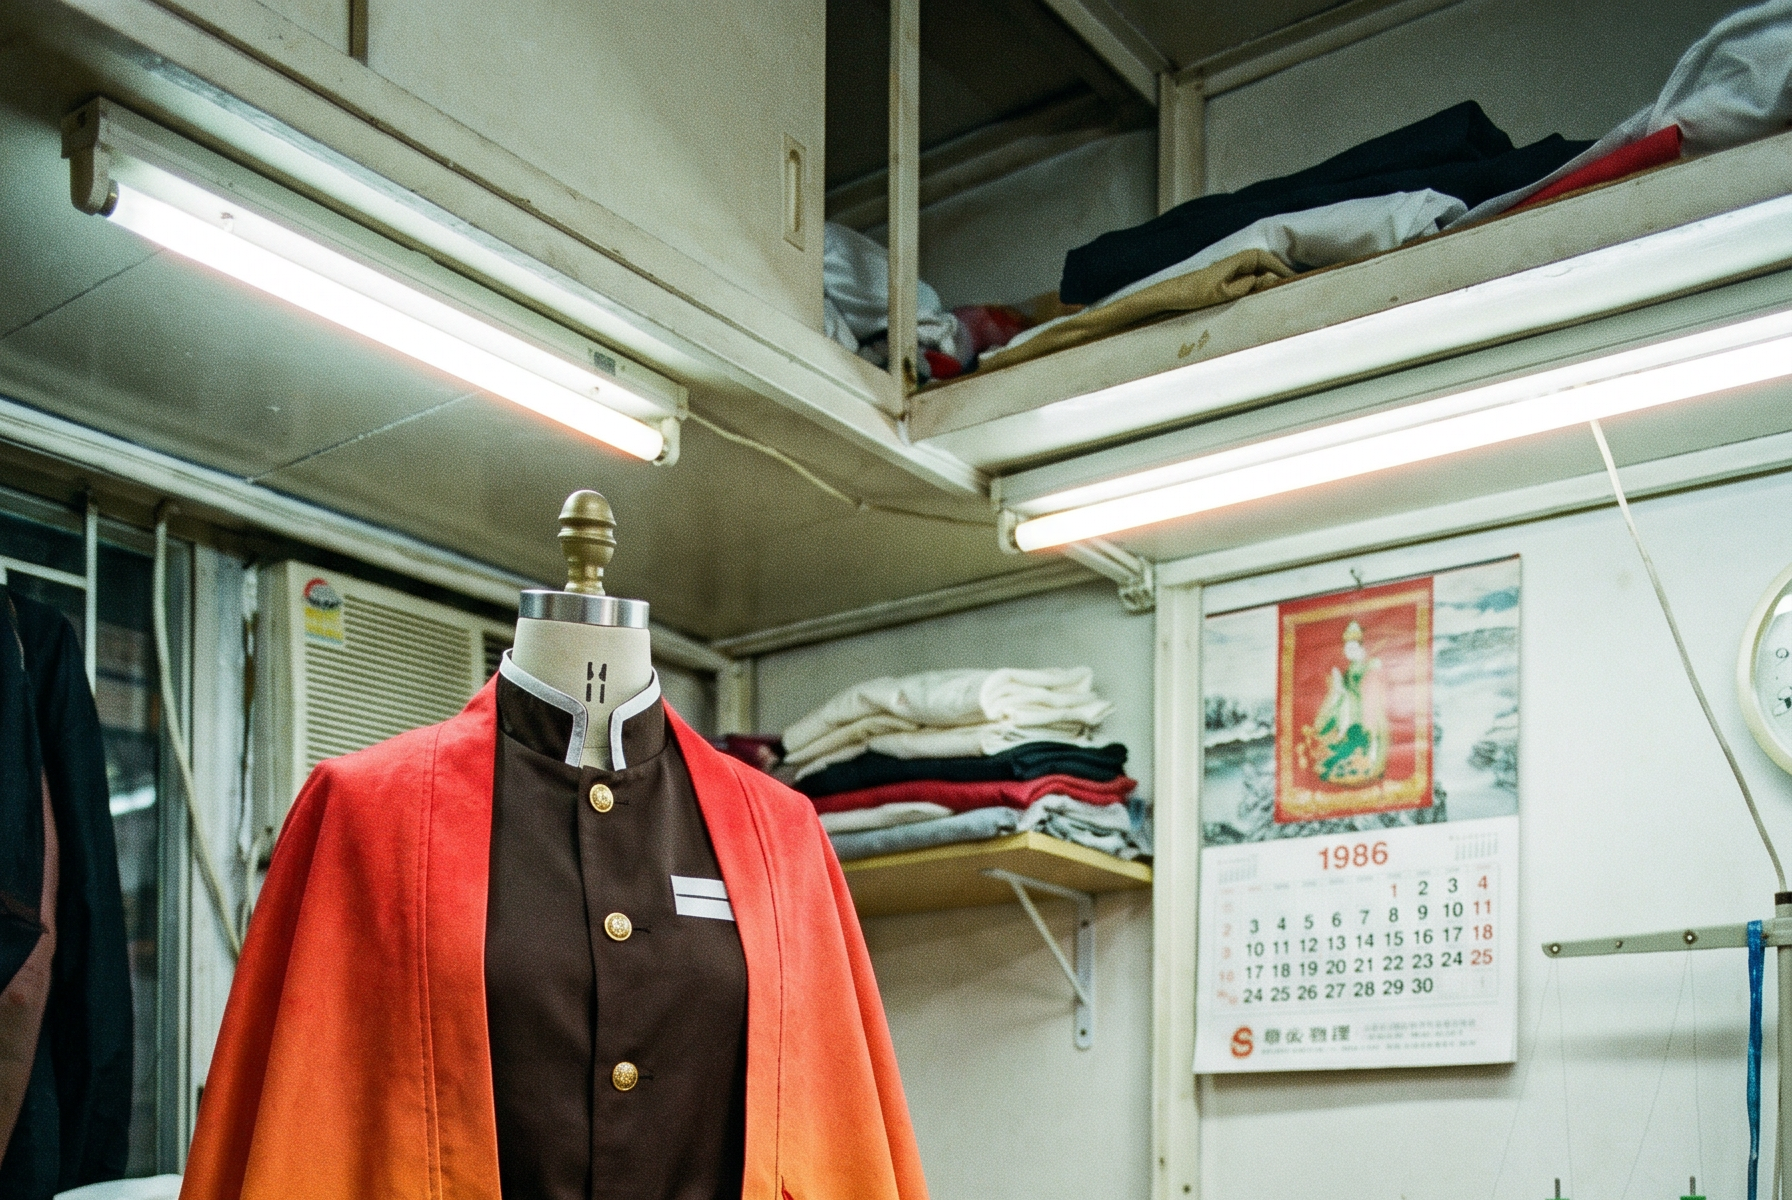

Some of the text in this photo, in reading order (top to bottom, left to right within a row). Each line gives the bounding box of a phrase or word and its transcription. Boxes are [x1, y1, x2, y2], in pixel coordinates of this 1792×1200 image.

[1318, 840, 1389, 871] 1986
[1390, 875, 1489, 898] 1 2 3 4
[1249, 918, 1260, 935] 3
[1276, 916, 1287, 931] 4
[1303, 913, 1315, 930] 5
[1331, 911, 1343, 928] 6
[1359, 909, 1370, 925] 7
[1388, 906, 1399, 924] 8
[1417, 904, 1429, 921] 9
[1443, 901, 1464, 918] 10
[1473, 899, 1492, 916] 11
[1245, 941, 1265, 958] 10
[1272, 940, 1290, 955] 11
[1299, 937, 1319, 954] 12
[1327, 935, 1347, 951] 13
[1355, 932, 1375, 949] 14
[1384, 930, 1405, 947] 15
[1413, 928, 1434, 945] 16
[1443, 925, 1464, 943] 17
[1472, 923, 1494, 941] 18
[1245, 964, 1264, 980] 17
[1272, 962, 1291, 979] 18
[1299, 960, 1319, 977] 19
[1325, 959, 1347, 976] 20
[1354, 956, 1374, 974] 21
[1382, 954, 1405, 972] 22
[1411, 952, 1434, 970] 23
[1440, 950, 1464, 968] 24
[1469, 948, 1494, 966] 25
[1243, 987, 1264, 1004] 24
[1270, 986, 1291, 1003] 25
[1297, 984, 1318, 1001] 26
[1324, 982, 1347, 1000] 27
[1353, 981, 1376, 998] 28
[1382, 978, 1405, 996] 29
[1411, 977, 1434, 995] 30
[1231, 1026, 1254, 1059] S
